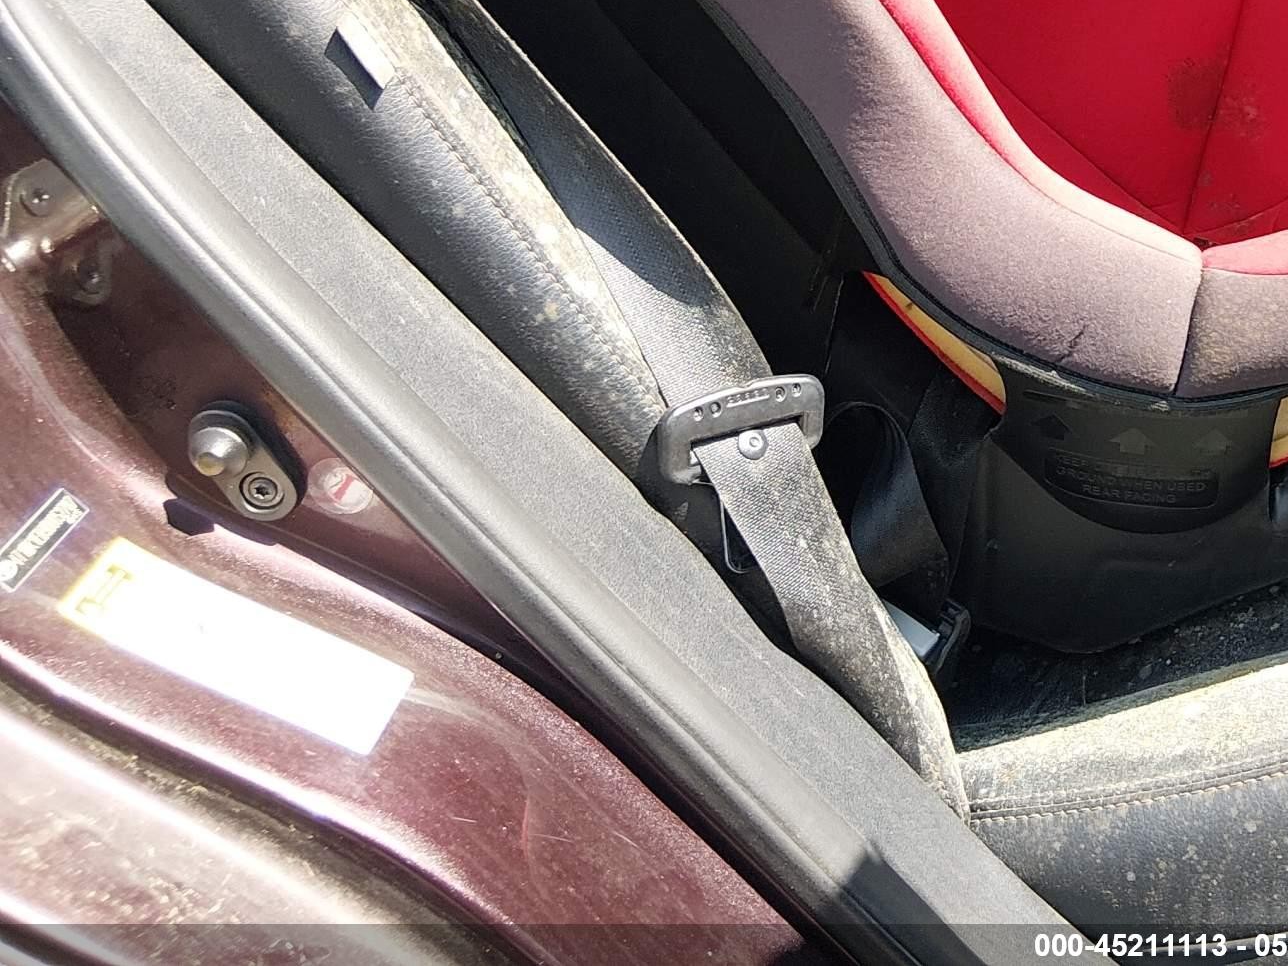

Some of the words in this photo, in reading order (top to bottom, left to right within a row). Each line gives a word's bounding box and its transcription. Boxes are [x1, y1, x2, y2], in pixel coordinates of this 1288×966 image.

[1056, 466, 1117, 486] GROUND
[1167, 482, 1208, 493] USED
[1082, 484, 1121, 499] REAR
